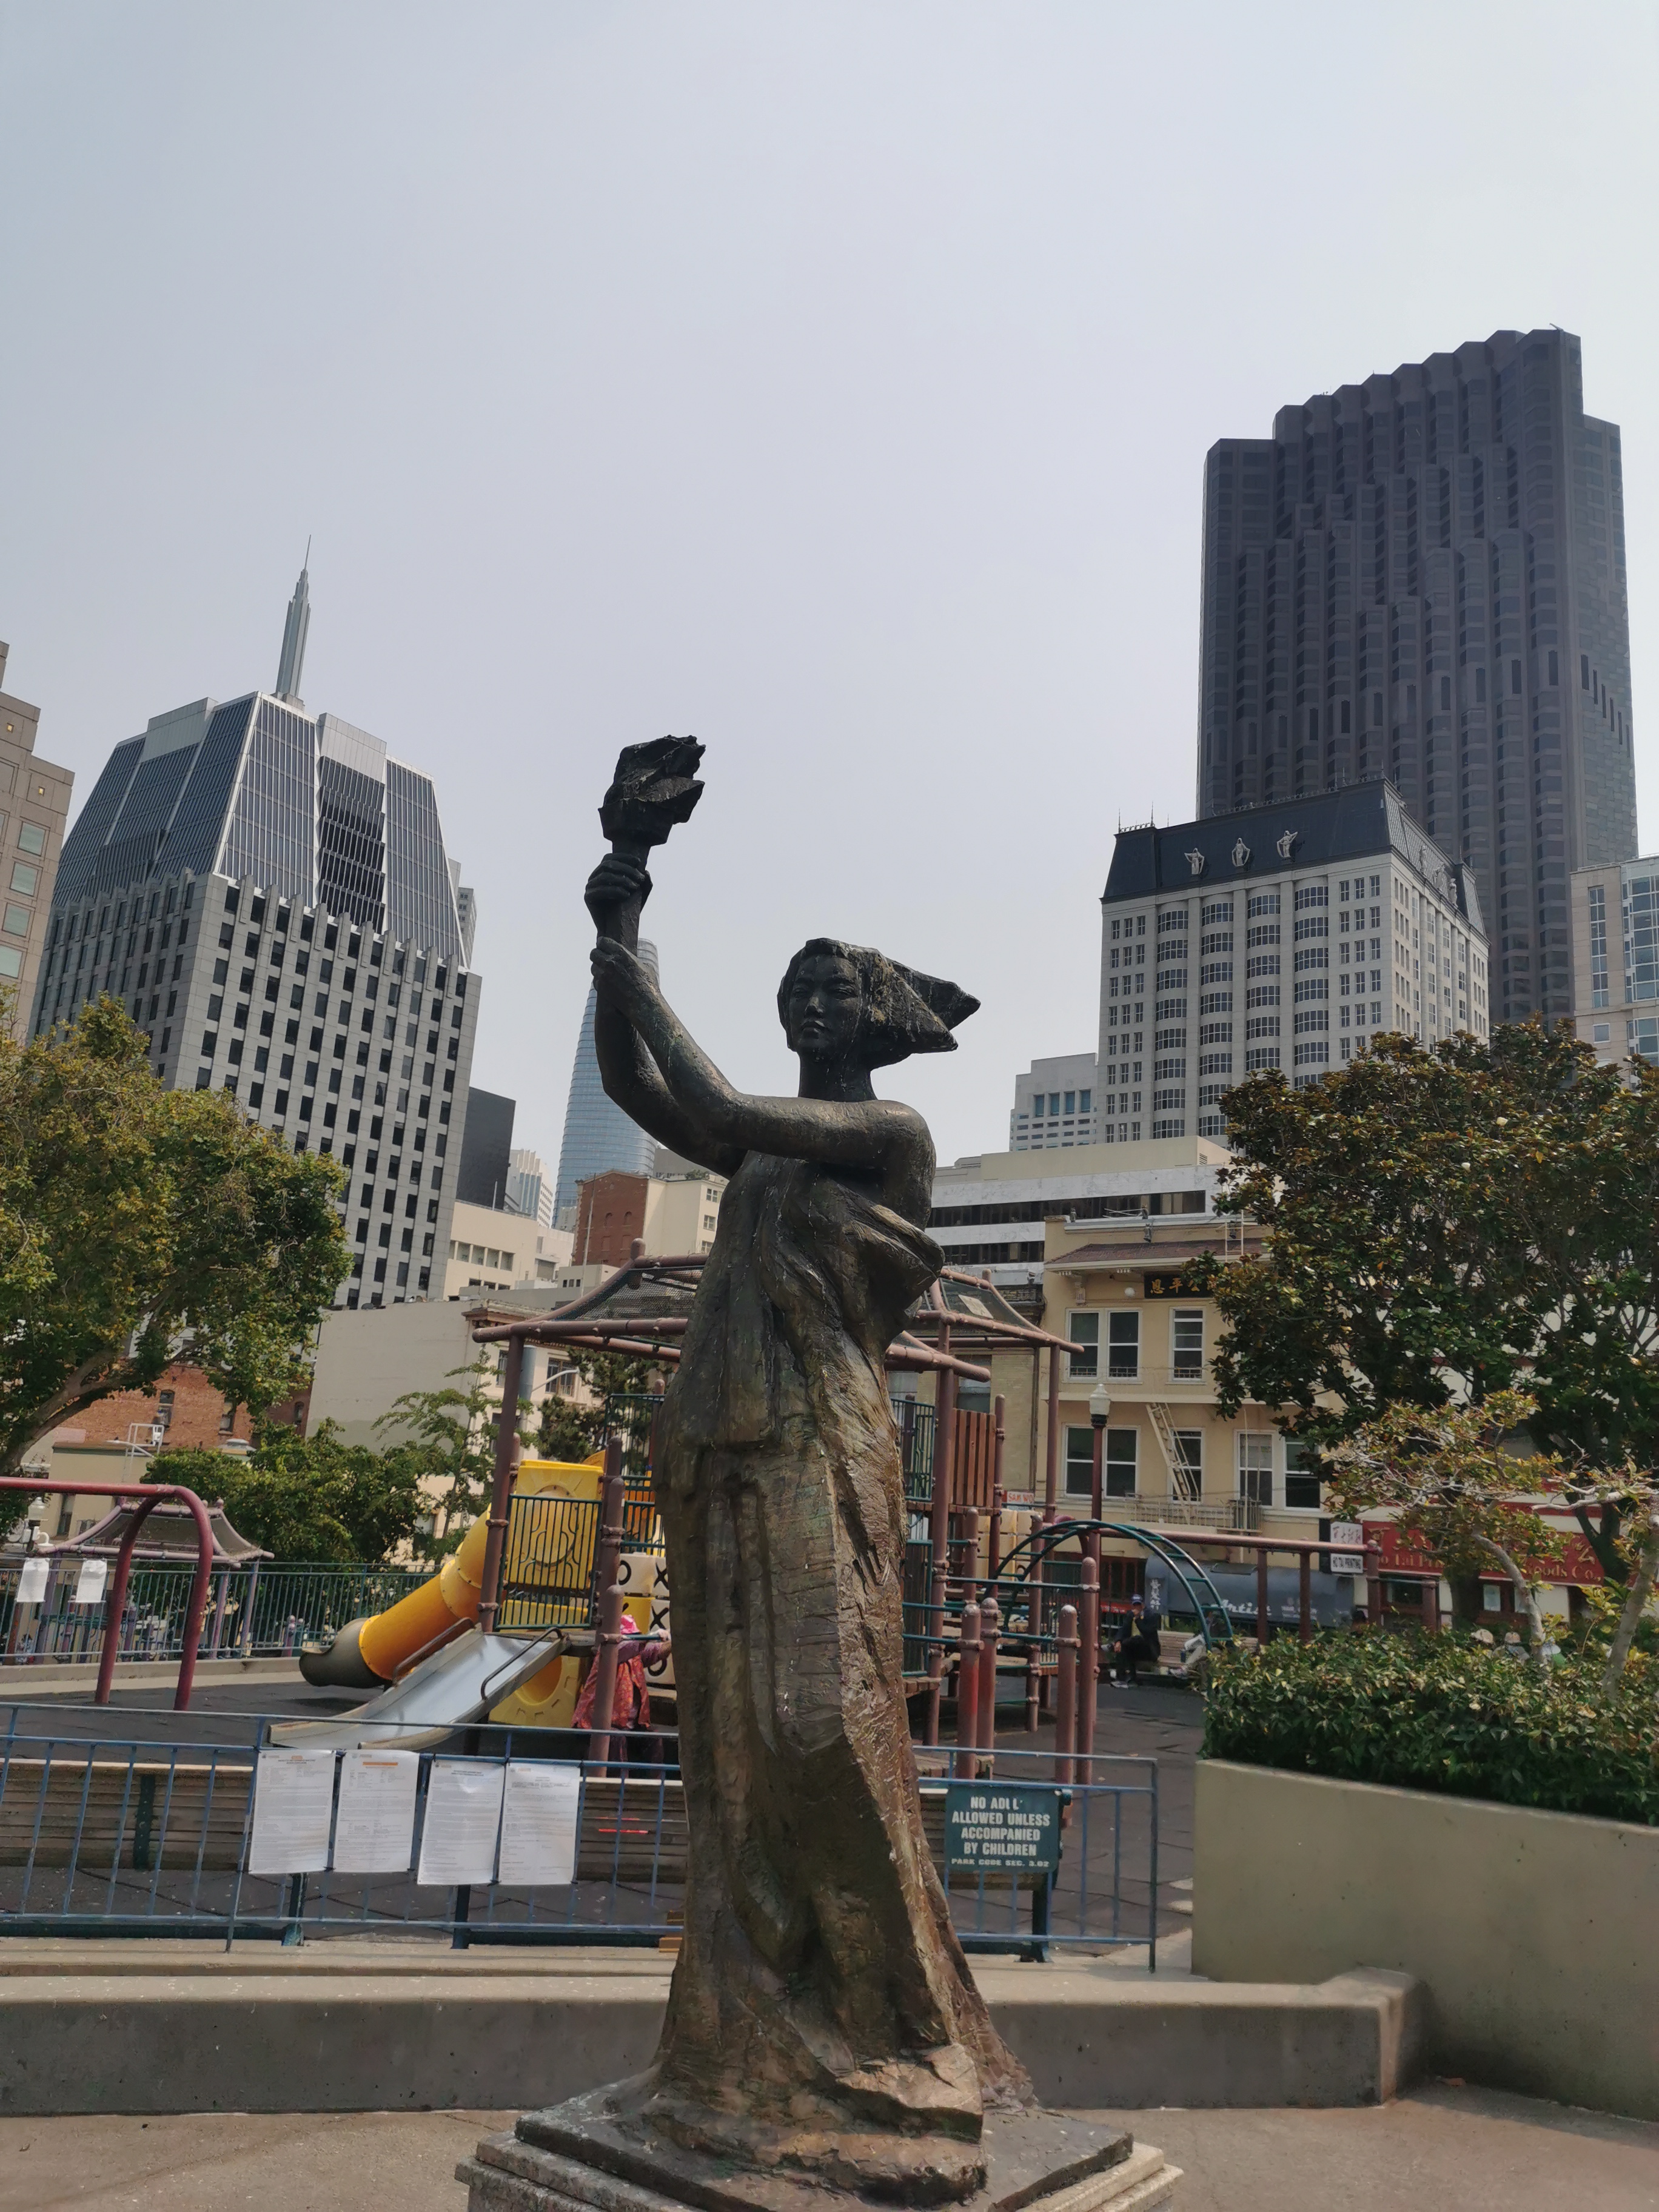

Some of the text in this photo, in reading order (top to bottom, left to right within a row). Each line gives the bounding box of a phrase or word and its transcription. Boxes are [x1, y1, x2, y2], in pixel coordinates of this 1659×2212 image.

[970, 1797, 986, 1809] NO
[952, 1811, 1050, 1826] ALLOWED UNLESS
[961, 1827, 1041, 1841] ACCOMPANIED
[964, 1842, 1037, 1856] BY CHILDREN
